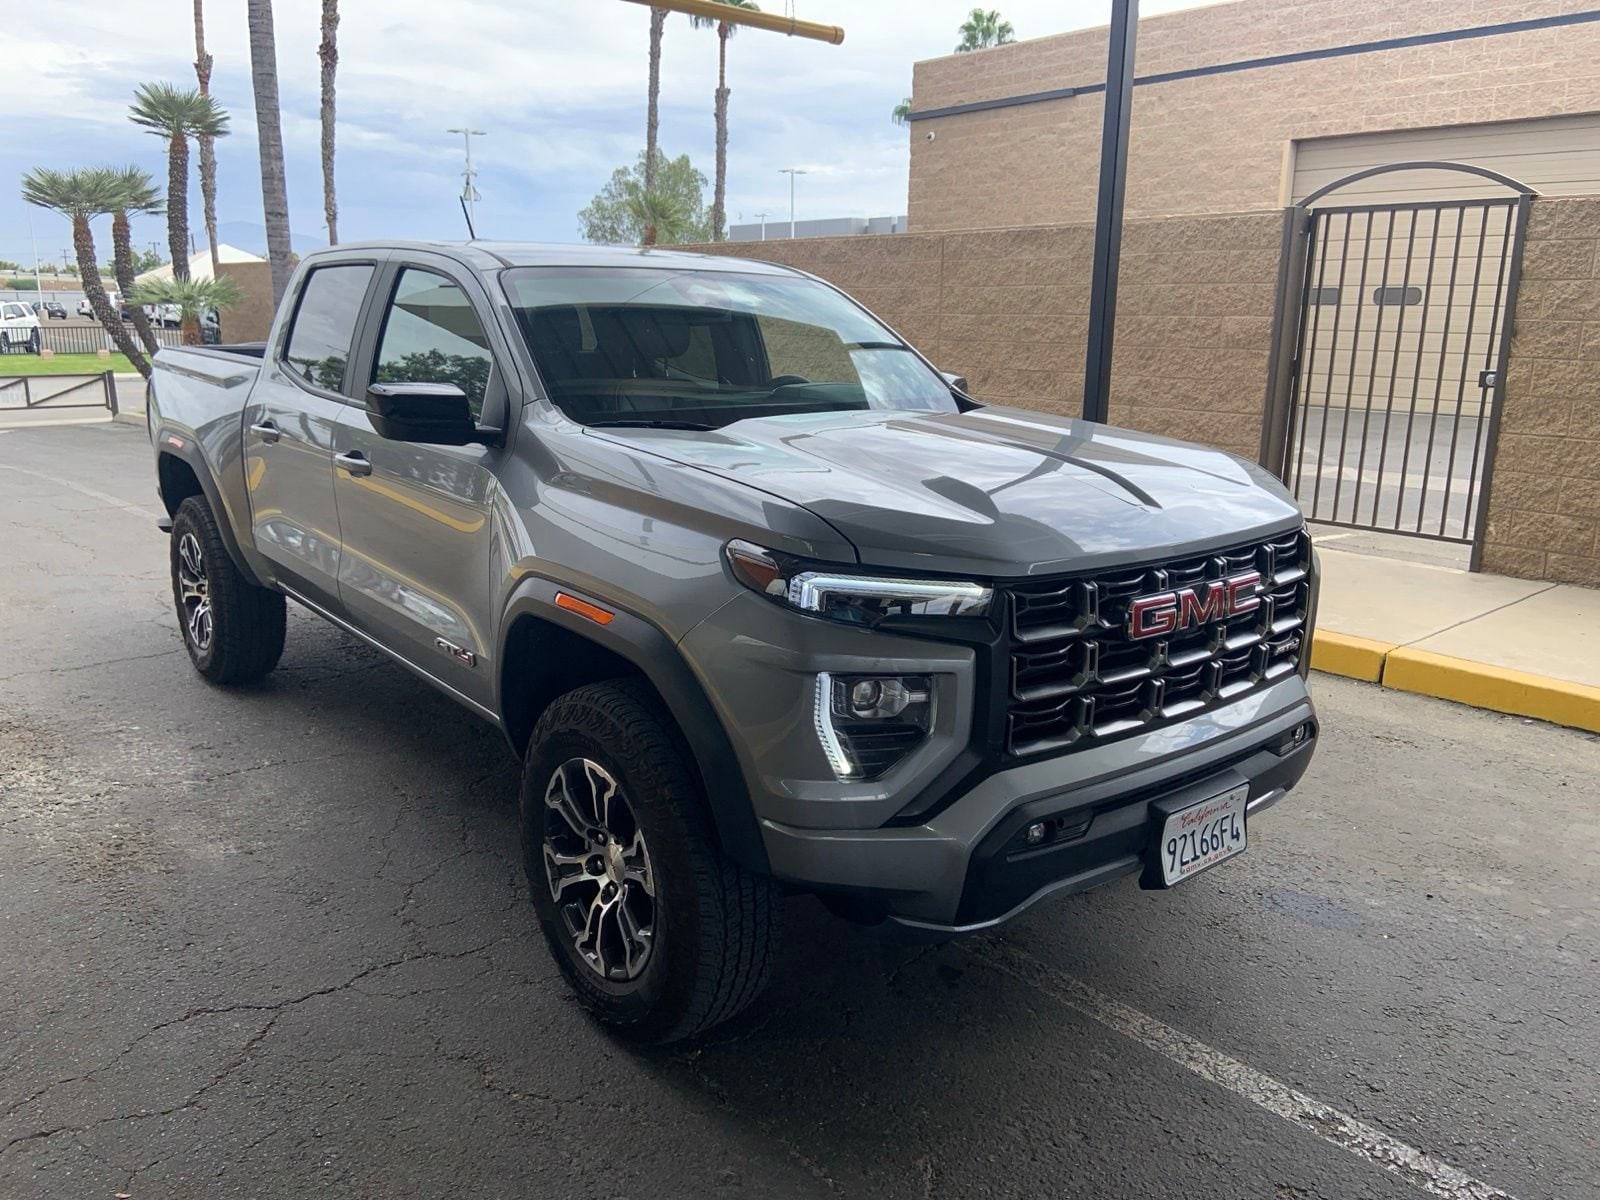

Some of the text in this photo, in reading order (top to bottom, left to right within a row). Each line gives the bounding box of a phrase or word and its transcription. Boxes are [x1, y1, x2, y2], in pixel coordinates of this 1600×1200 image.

[1128, 571, 1261, 641] GMC
[1167, 812, 1241, 873] 92166F4
[1180, 801, 1232, 829] California
